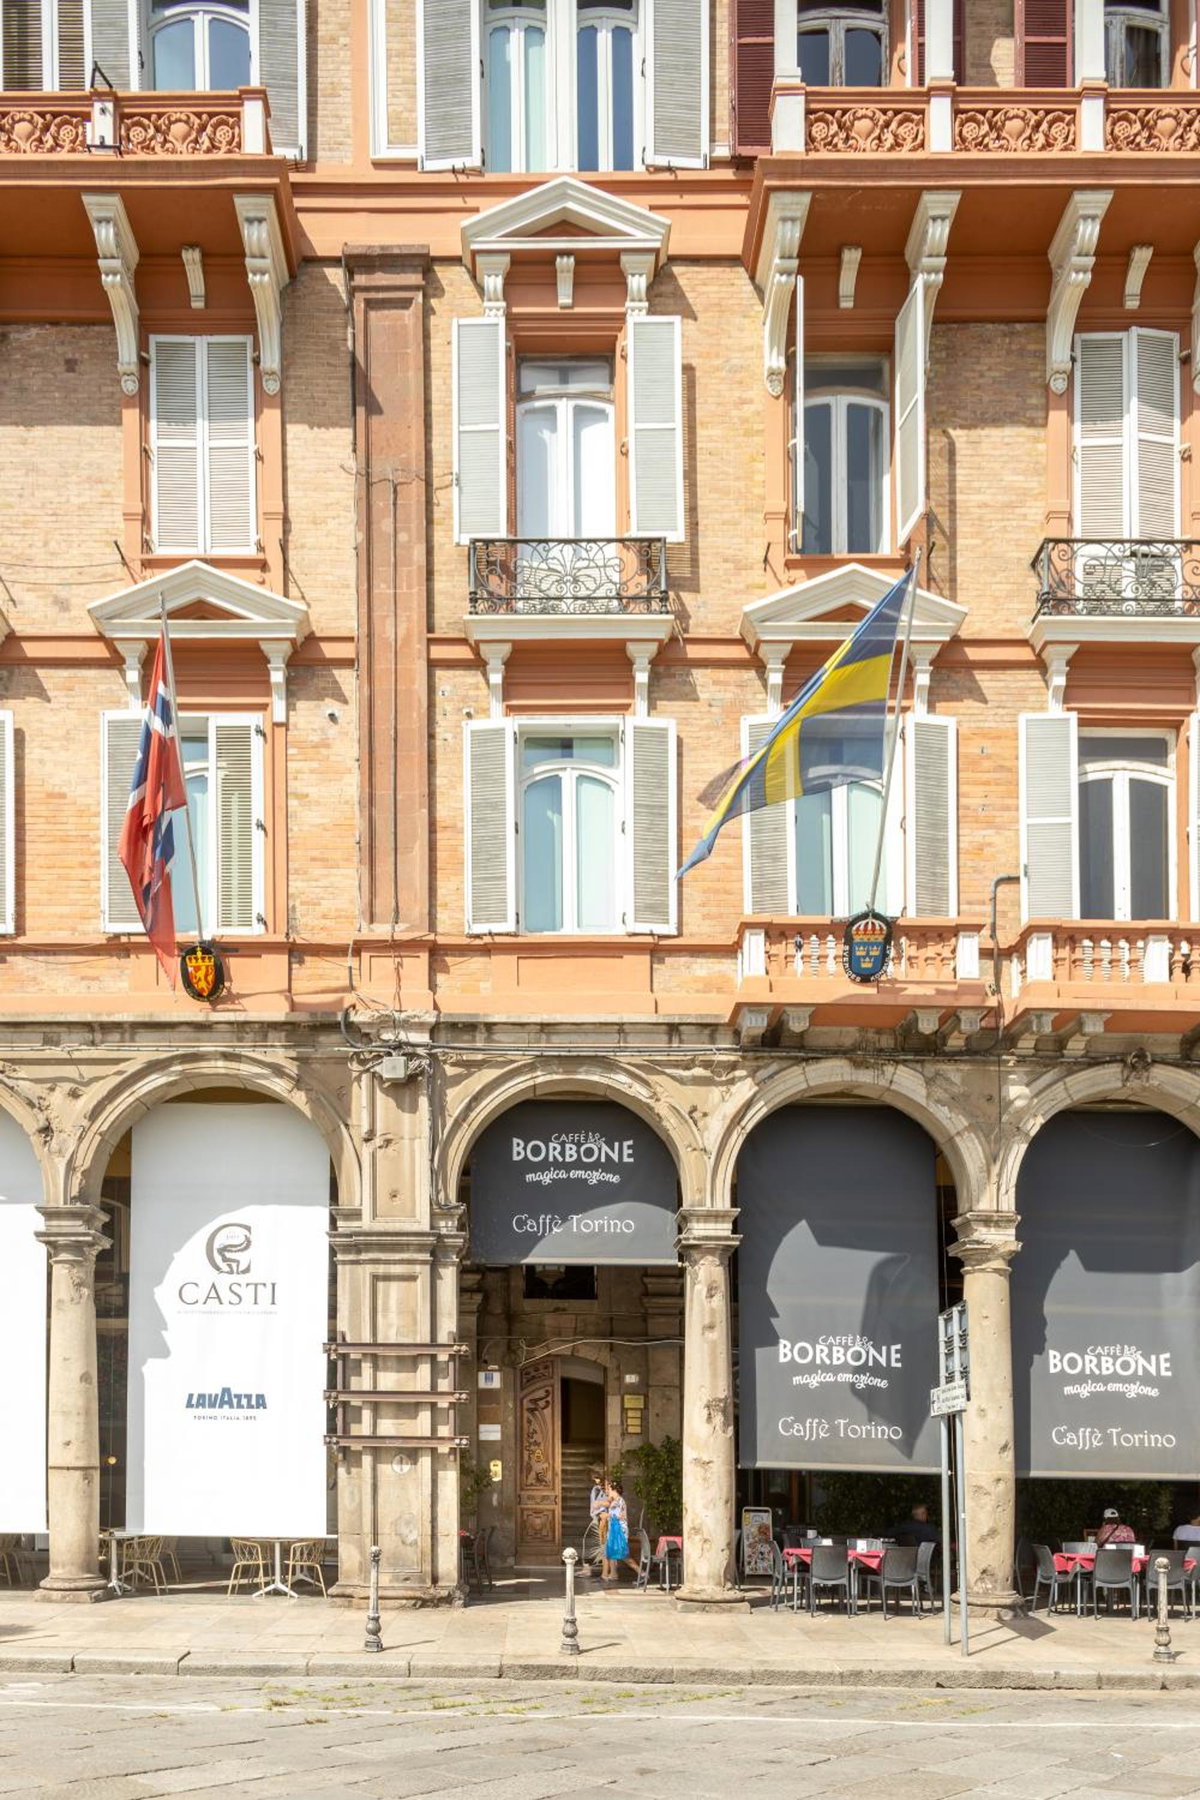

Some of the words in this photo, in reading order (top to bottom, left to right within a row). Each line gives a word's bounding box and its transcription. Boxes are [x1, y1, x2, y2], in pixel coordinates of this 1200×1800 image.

[512, 1137, 635, 1163] BORBONE
[525, 1167, 568, 1185] magica
[569, 1168, 621, 1185] emozione
[512, 1214, 563, 1236] Caffè
[567, 1214, 635, 1233] Torino
[178, 1282, 278, 1306] CASTI
[778, 1339, 902, 1368] BORBONE
[1048, 1349, 1173, 1377] BORBONE
[792, 1369, 836, 1389] magica
[837, 1370, 889, 1389] emozione
[1063, 1380, 1106, 1399] magica
[1107, 1381, 1160, 1399] emozione
[185, 1387, 268, 1410] LAVAZZA
[778, 1417, 831, 1441] Caffè
[834, 1418, 903, 1440] Torino
[1052, 1425, 1103, 1450] Caffè
[1107, 1427, 1177, 1448] Torino
